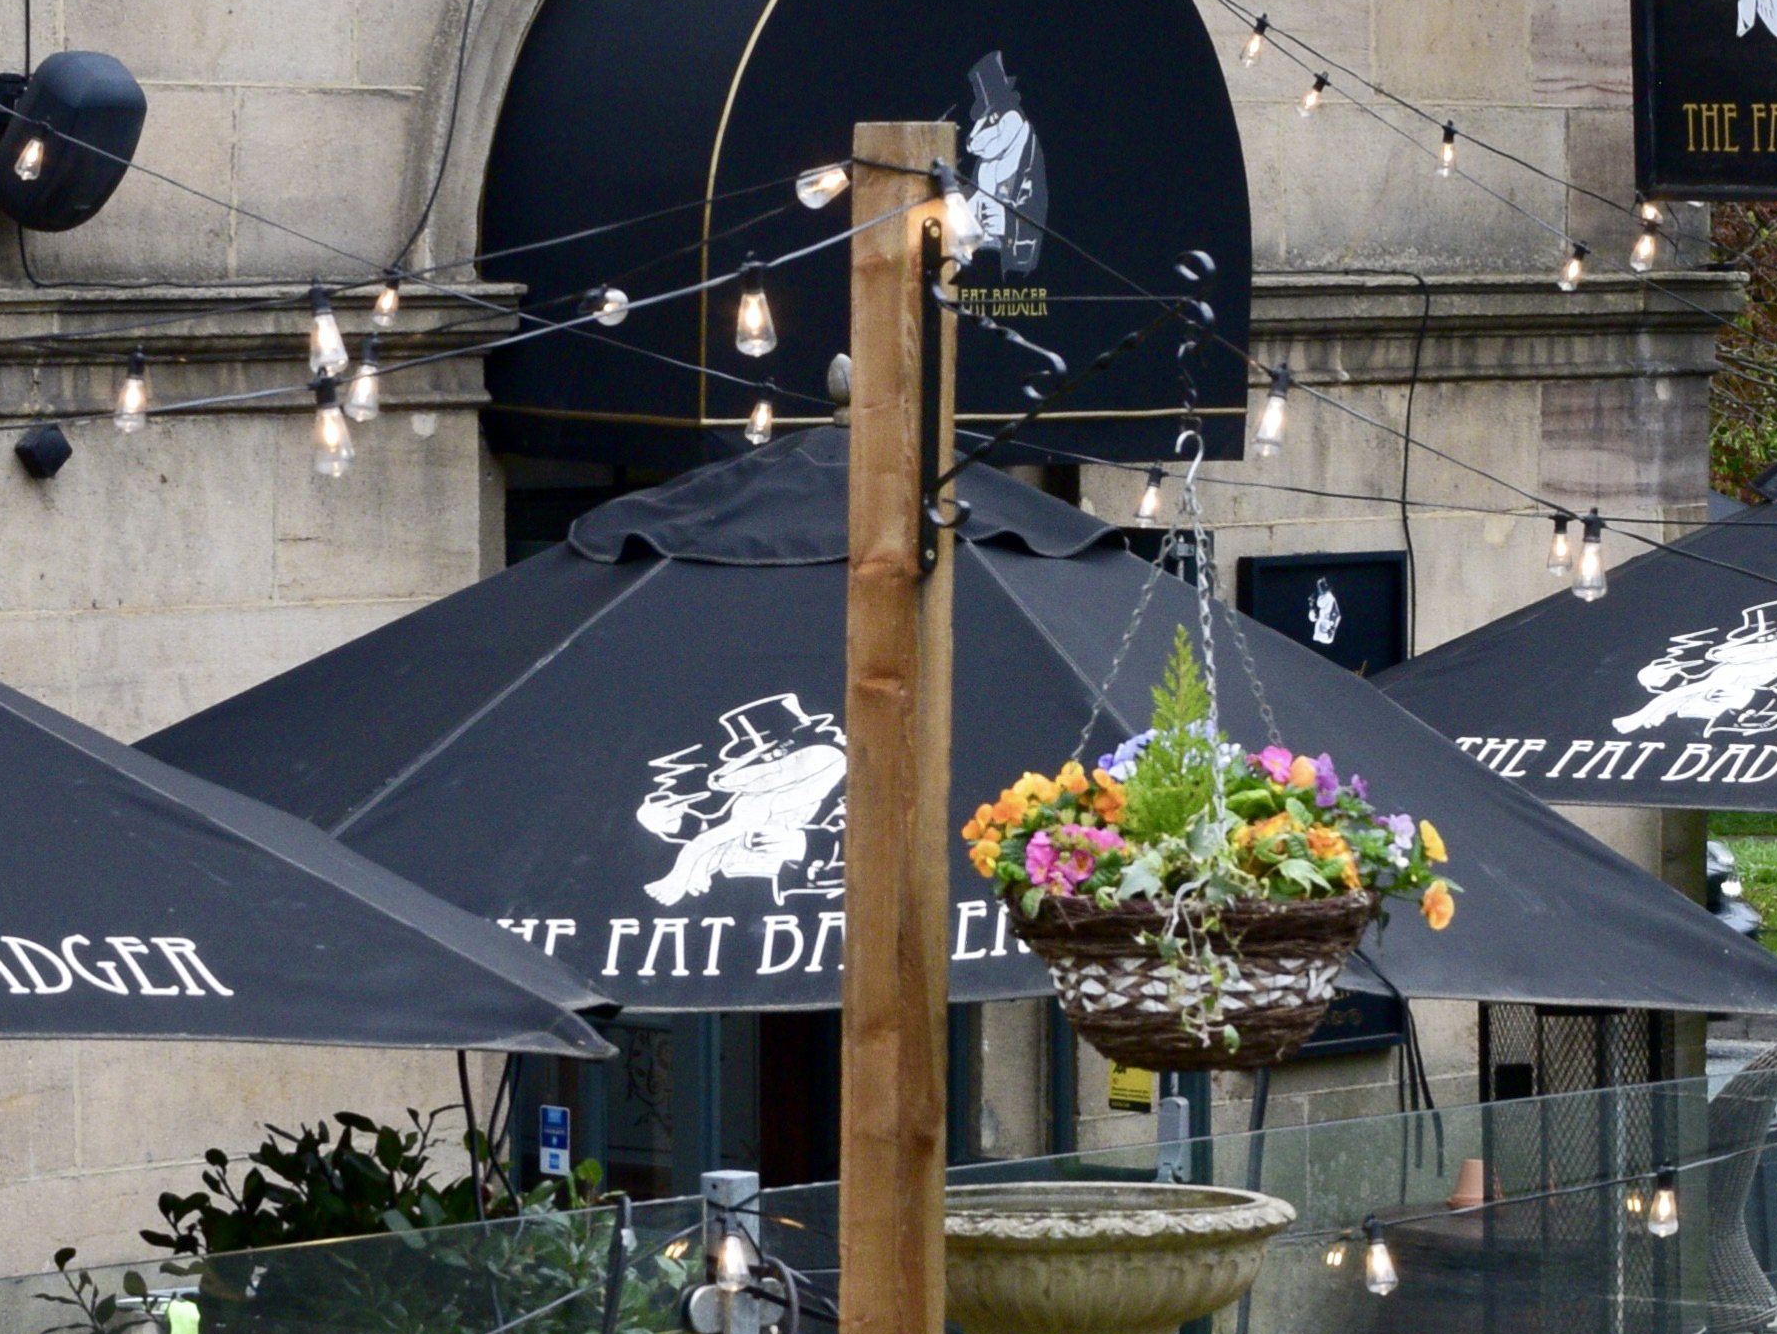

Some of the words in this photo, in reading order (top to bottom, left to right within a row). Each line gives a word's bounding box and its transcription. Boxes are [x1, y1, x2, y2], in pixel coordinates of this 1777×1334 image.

[1683, 103, 1738, 153] THE
[961, 288, 988, 316] FAT
[992, 288, 1047, 316] BADGER
[1455, 736, 1547, 777] THE
[1546, 740, 1665, 780] FAT
[601, 917, 735, 977] FAT
[756, 899, 1031, 975] BAE
